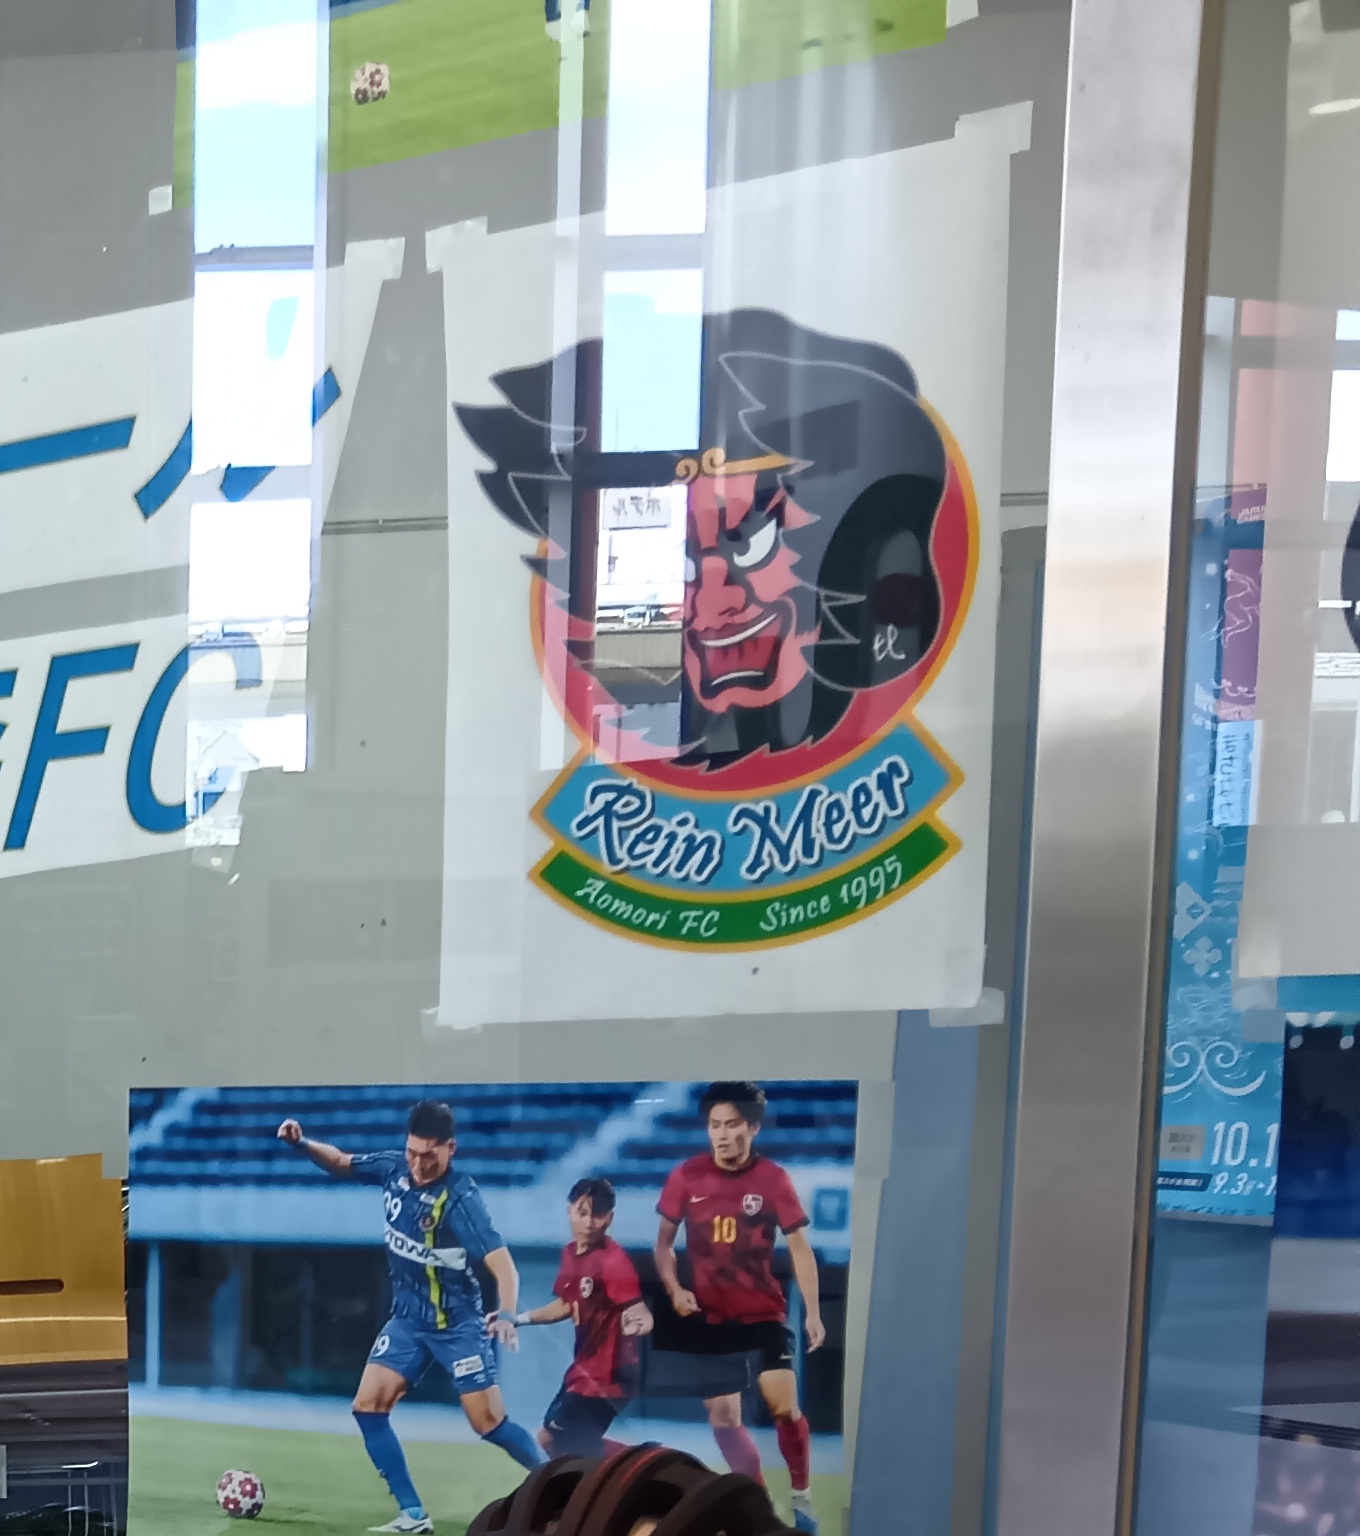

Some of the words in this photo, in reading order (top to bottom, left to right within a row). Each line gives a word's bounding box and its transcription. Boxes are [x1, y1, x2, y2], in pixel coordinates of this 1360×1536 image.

[571, 778, 726, 886] Rein
[729, 755, 913, 883] Meer
[575, 875, 669, 932] Aomori
[678, 909, 721, 937] FC
[759, 894, 833, 933] Since
[838, 853, 905, 913] 1995
[712, 1214, 737, 1244] 10
